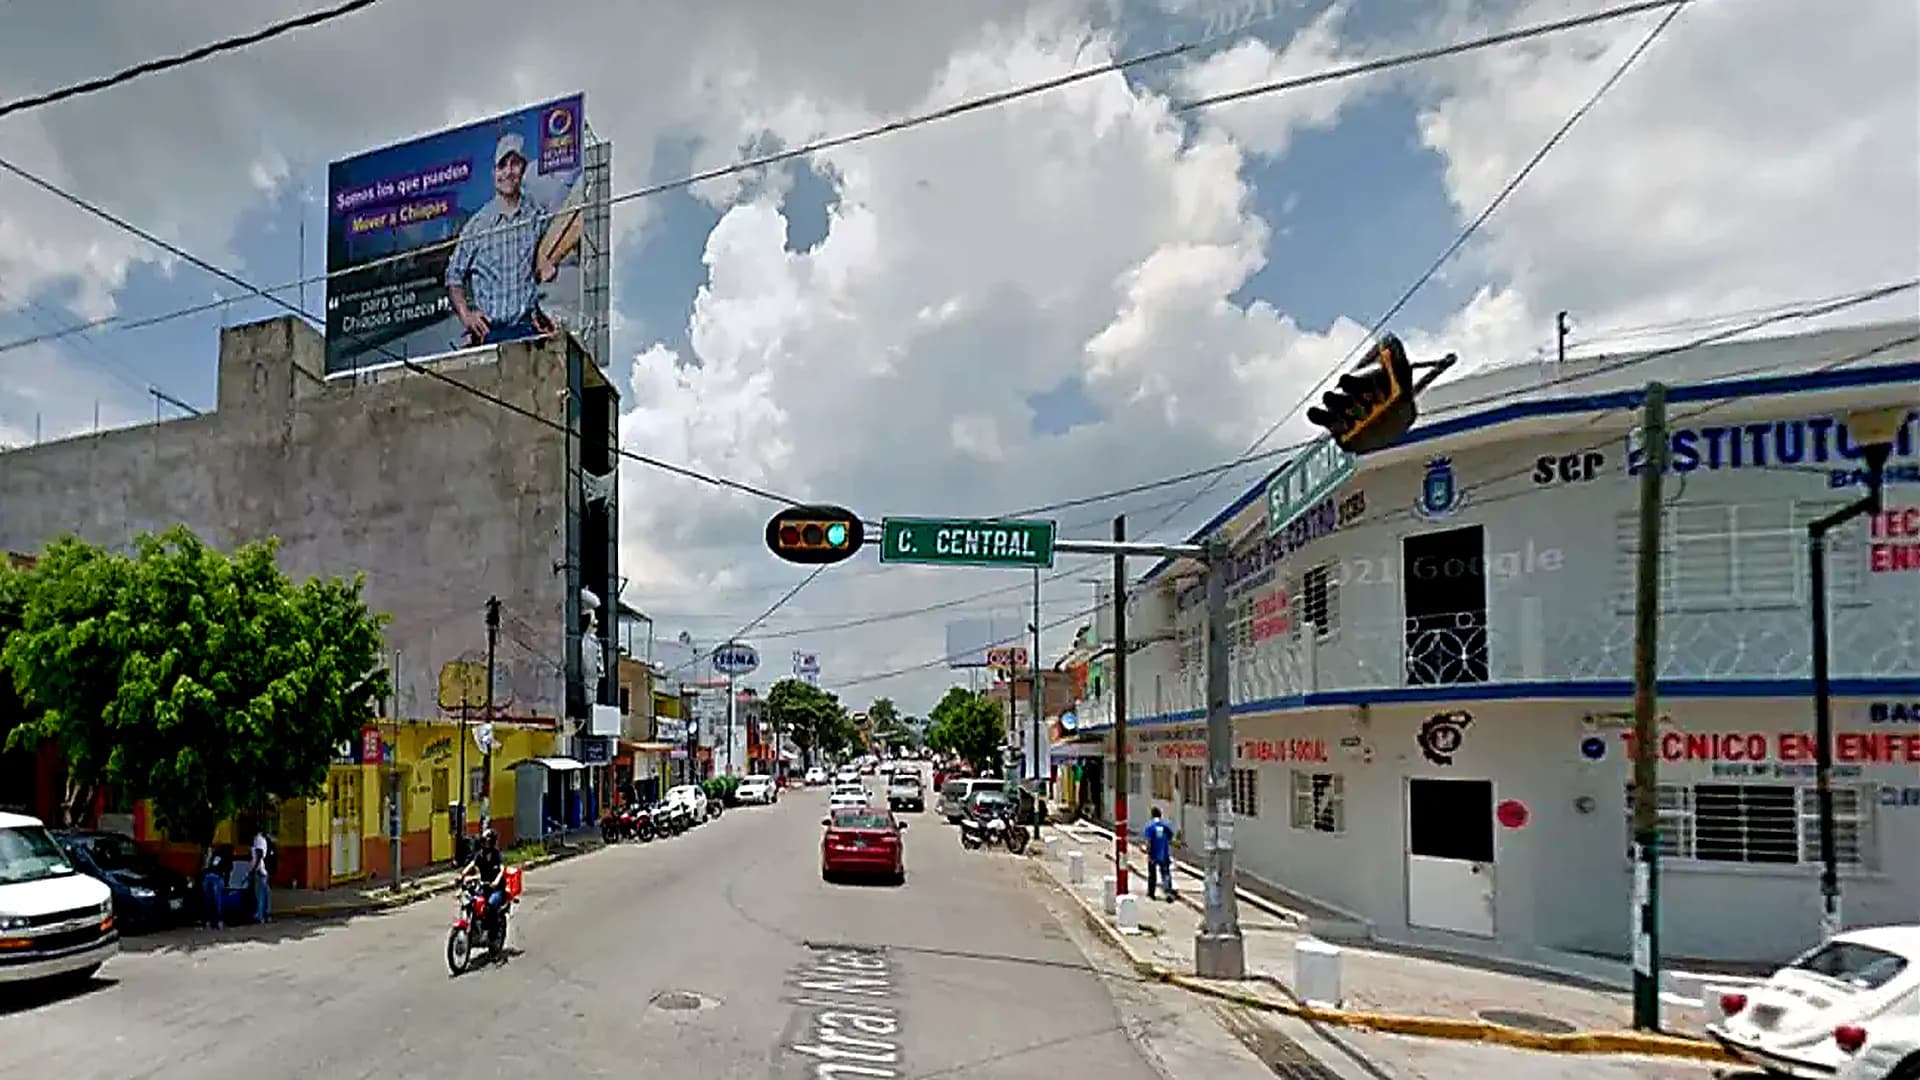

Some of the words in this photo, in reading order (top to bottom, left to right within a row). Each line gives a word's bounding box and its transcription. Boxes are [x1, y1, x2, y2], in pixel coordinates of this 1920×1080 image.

[336, 185, 375, 211] Somos
[377, 180, 395, 198] los
[397, 174, 420, 196] que
[423, 163, 468, 192] pueden
[399, 200, 449, 222] Chiapas
[898, 528, 918, 553] C.
[936, 529, 1036, 557] CENTRAL
[987, 648, 1028, 666] OXO
[1619, 732, 1768, 761] TCNICO
